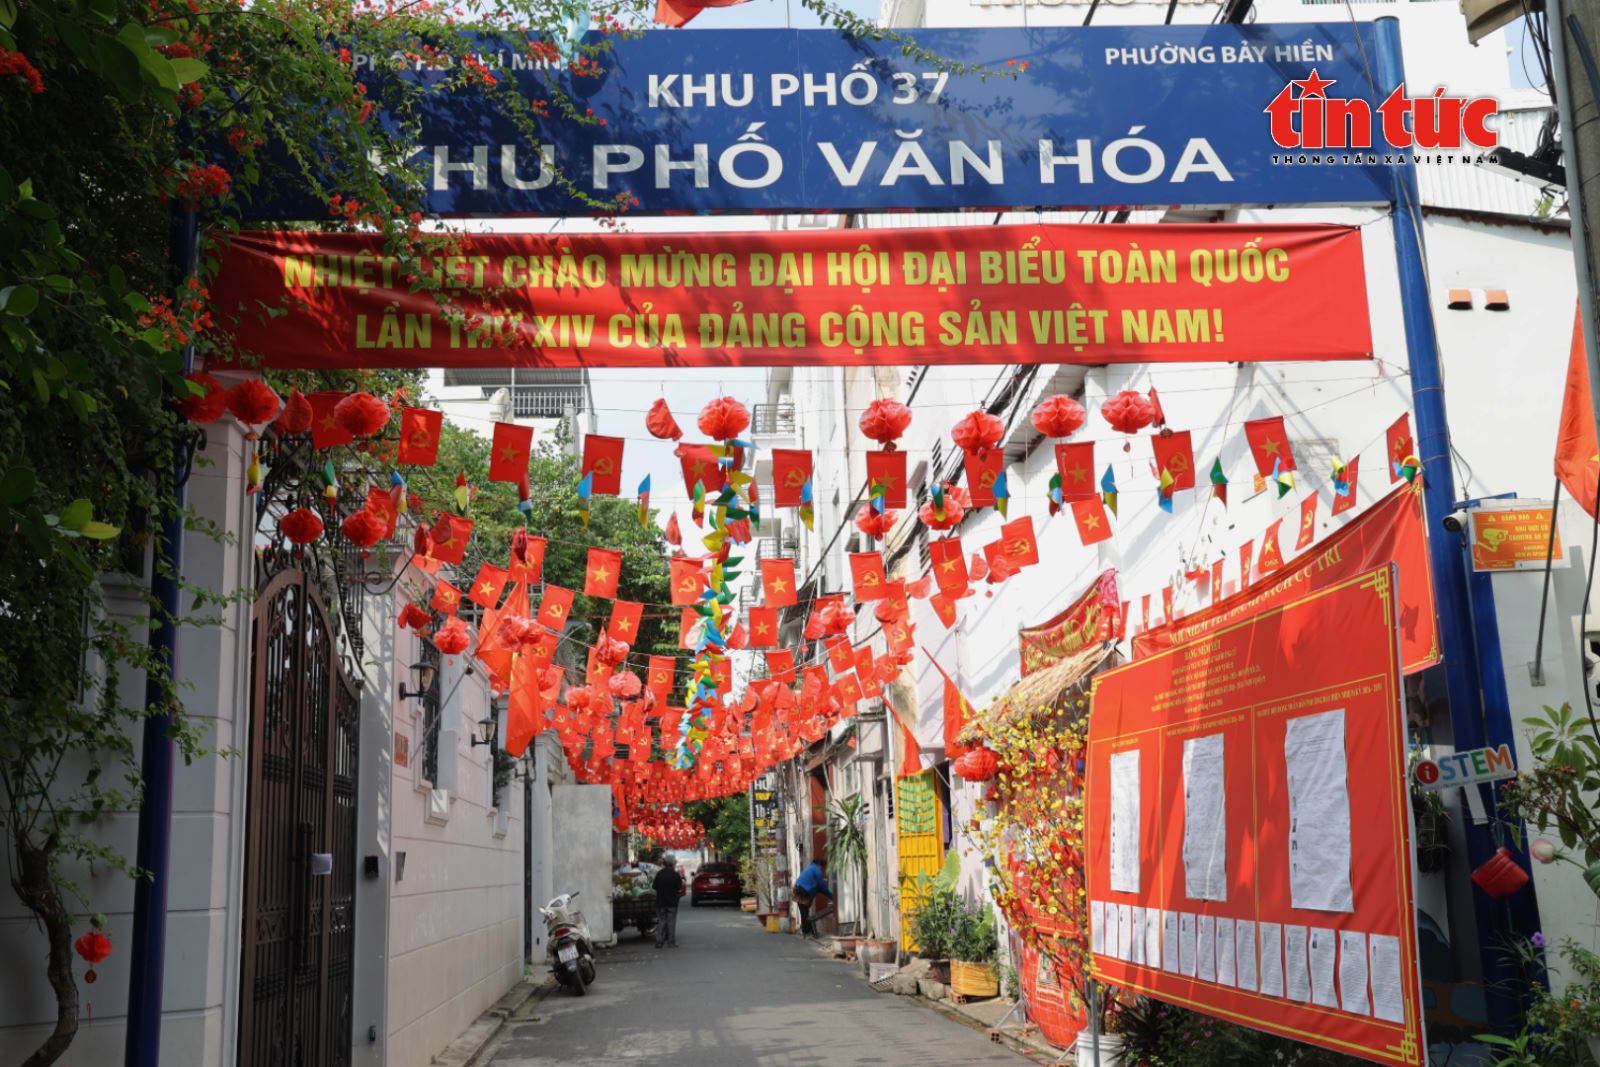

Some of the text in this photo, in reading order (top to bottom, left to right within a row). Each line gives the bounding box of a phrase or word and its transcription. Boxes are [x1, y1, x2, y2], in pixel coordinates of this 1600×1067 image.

[1105, 37, 1335, 66] PHƯỜNG BẢY HIỀN
[648, 57, 950, 109] KHU PHỐ 37
[366, 121, 1235, 192] KHU PHỐ VĂN HÓA
[285, 249, 398, 295] NHIỆT
[502, 247, 606, 289] CHÀO
[620, 246, 736, 288] MỪNG
[749, 252, 813, 295] ĐẠI
[828, 244, 890, 294] HỘI
[903, 252, 967, 293] ĐẠI
[981, 236, 1066, 285] BIỂU
[1077, 242, 1177, 285] TOÀN
[1190, 237, 1290, 286] QUỐC
[355, 300, 432, 349] LẦN
[533, 314, 595, 348] XIV
[608, 301, 686, 349] CỦA
[698, 300, 806, 349] ĐẢNG
[819, 304, 926, 355] CỘNG
[939, 299, 1017, 346] SẢN
[1029, 302, 1109, 352] VIỆT
[1121, 308, 1226, 345] NAM!
[1417, 745, 1513, 785] iSTEM
